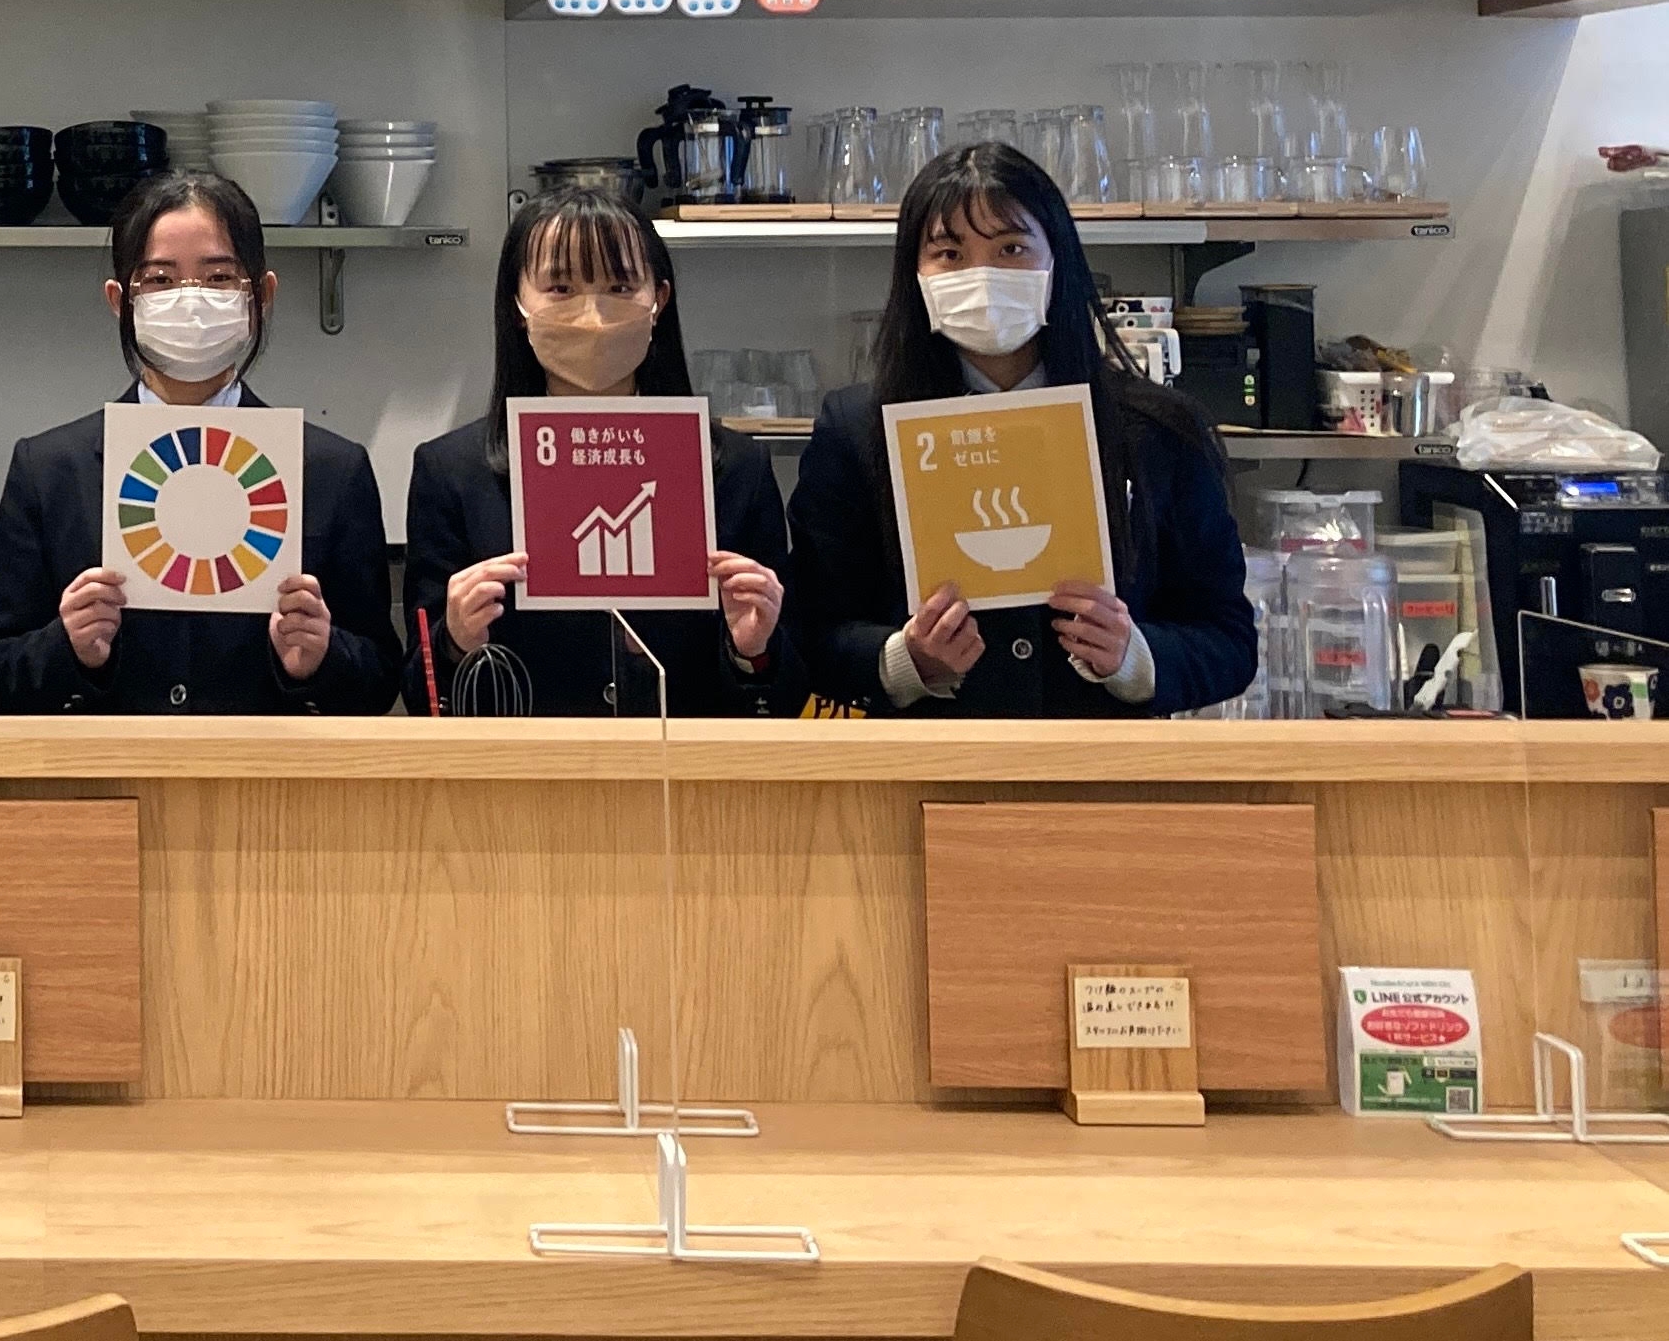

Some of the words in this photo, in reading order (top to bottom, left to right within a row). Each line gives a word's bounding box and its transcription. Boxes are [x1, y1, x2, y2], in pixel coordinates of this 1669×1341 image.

[570, 427, 645, 444] 働きがいも
[536, 426, 557, 467] 8
[916, 431, 938, 472] 2
[571, 448, 646, 466] 経済成長も
[953, 449, 1000, 468] ゼロに
[1371, 991, 1400, 1003] LINE
